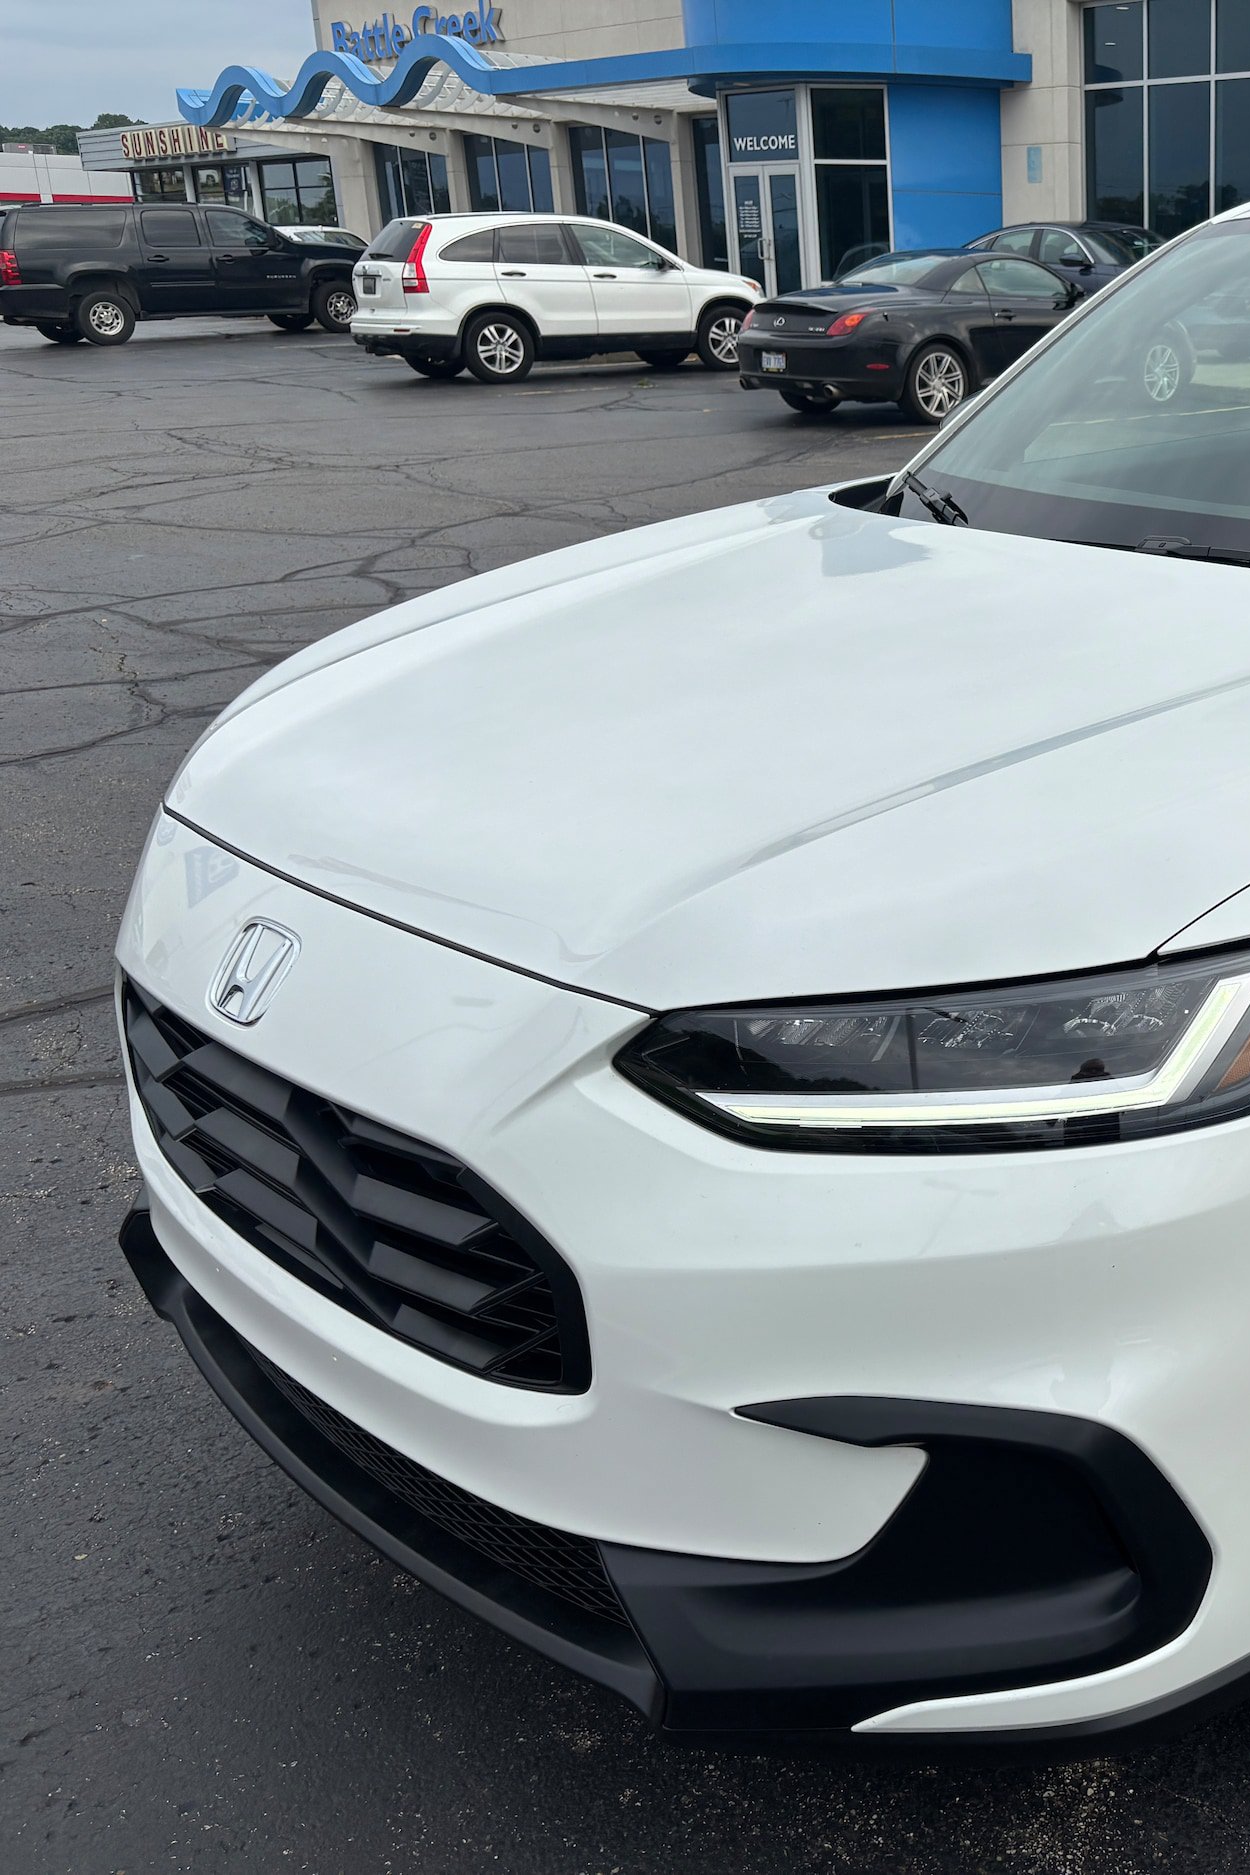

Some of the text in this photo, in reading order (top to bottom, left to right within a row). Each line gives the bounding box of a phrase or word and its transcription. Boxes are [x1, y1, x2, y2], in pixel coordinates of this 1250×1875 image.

[331, 0, 502, 63] Battle Creek
[121, 126, 225, 158] SUNSHINE
[734, 134, 796, 151] WELCOME
